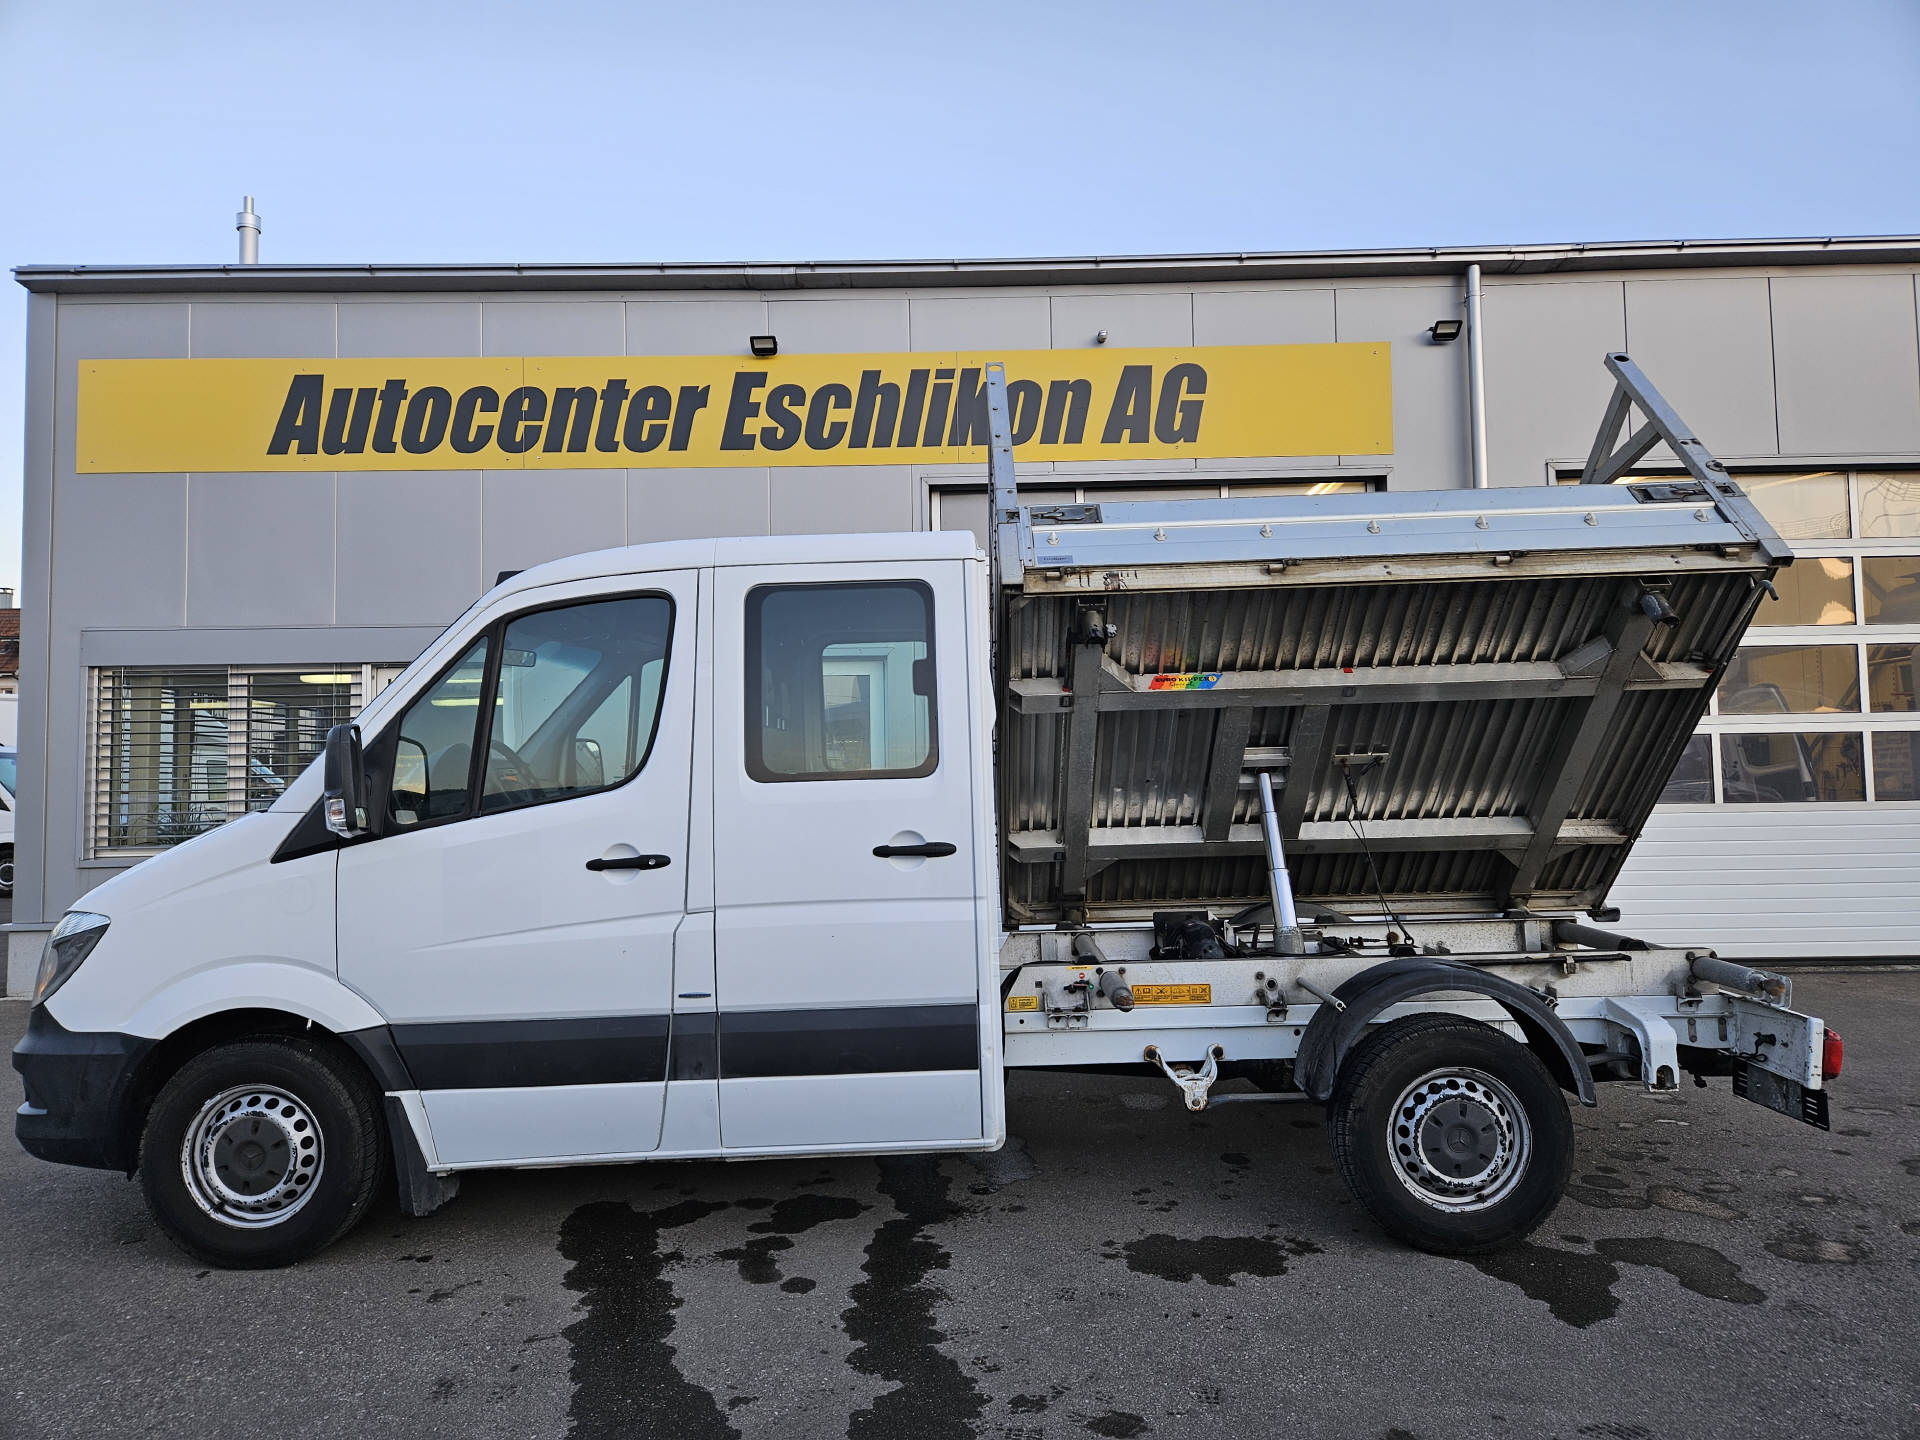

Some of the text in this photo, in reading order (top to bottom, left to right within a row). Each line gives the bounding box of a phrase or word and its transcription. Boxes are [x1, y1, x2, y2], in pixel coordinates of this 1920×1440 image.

[268, 363, 1207, 455] Autocenter Eschlikon AG
